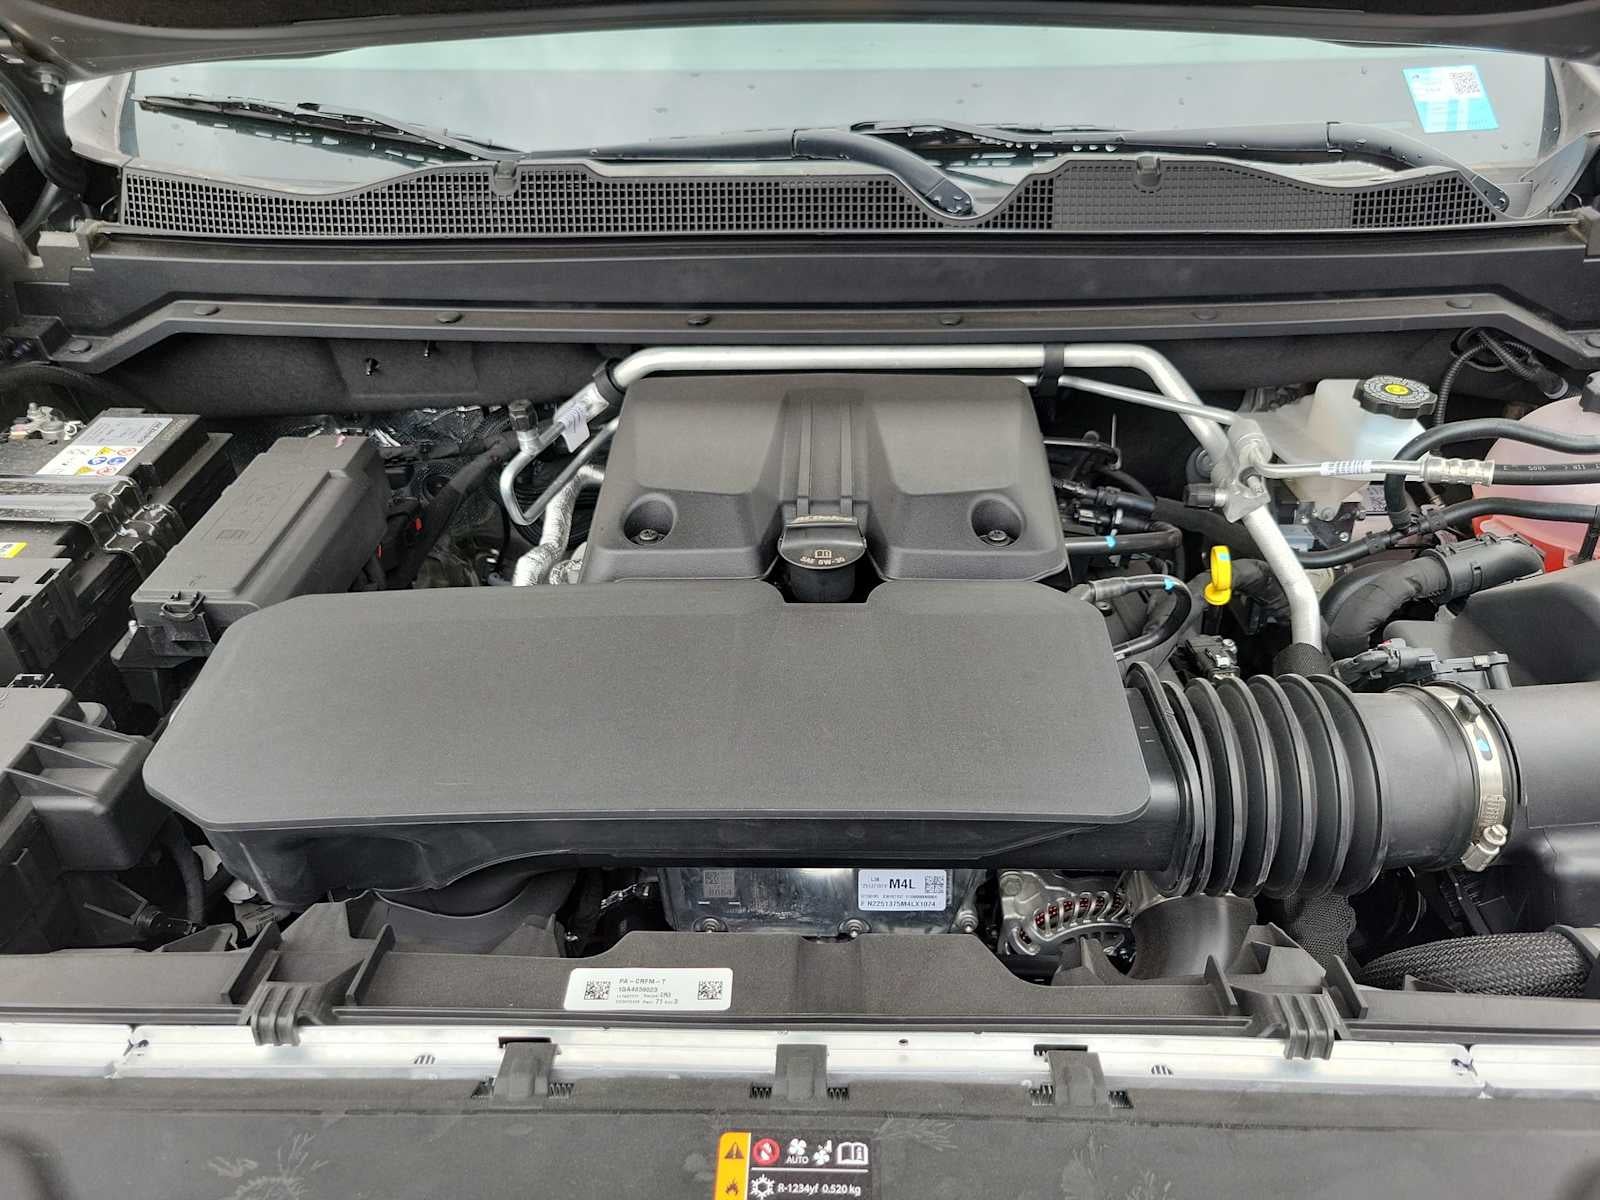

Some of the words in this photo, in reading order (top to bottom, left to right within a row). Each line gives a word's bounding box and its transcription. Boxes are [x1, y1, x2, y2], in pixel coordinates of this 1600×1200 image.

[889, 878, 916, 889] M4L
[786, 1156, 809, 1164] AUTO
[777, 1183, 819, 1196] R-1234yf
[822, 1183, 847, 1194] 0.520
[849, 1184, 862, 1197] kg
